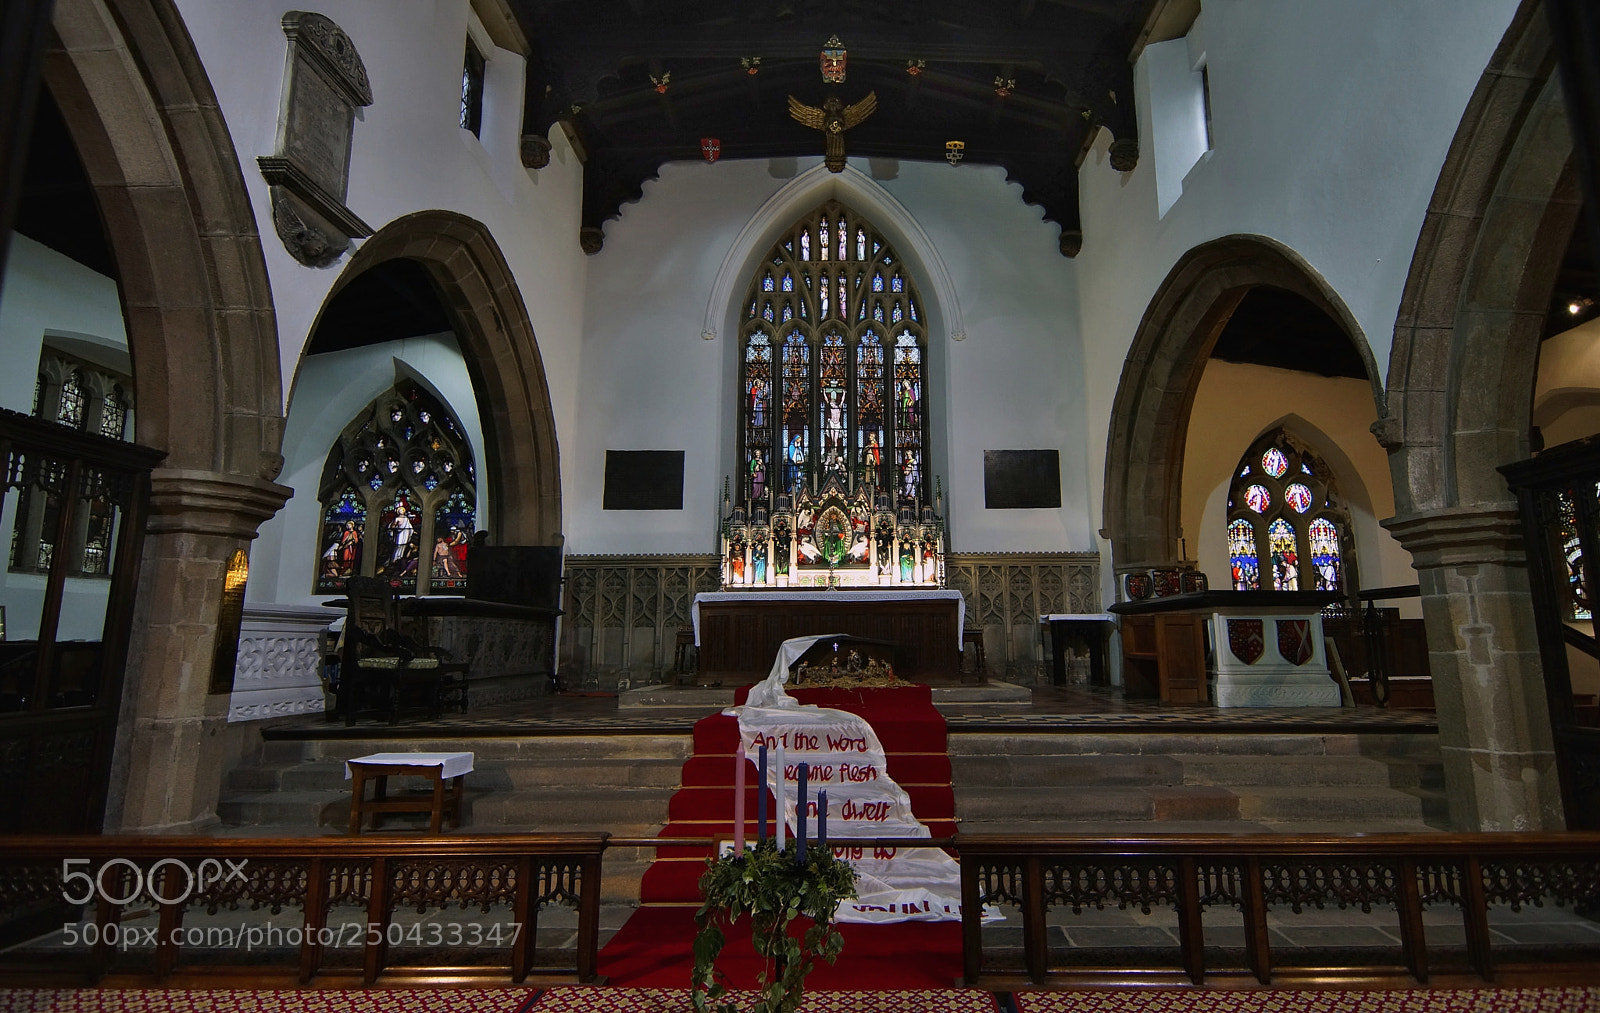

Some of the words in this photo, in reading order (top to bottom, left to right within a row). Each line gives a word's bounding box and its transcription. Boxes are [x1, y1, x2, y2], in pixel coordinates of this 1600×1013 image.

[794, 732, 820, 750] the
[839, 763, 877, 783] flesh
[842, 799, 891, 822] dwelt
